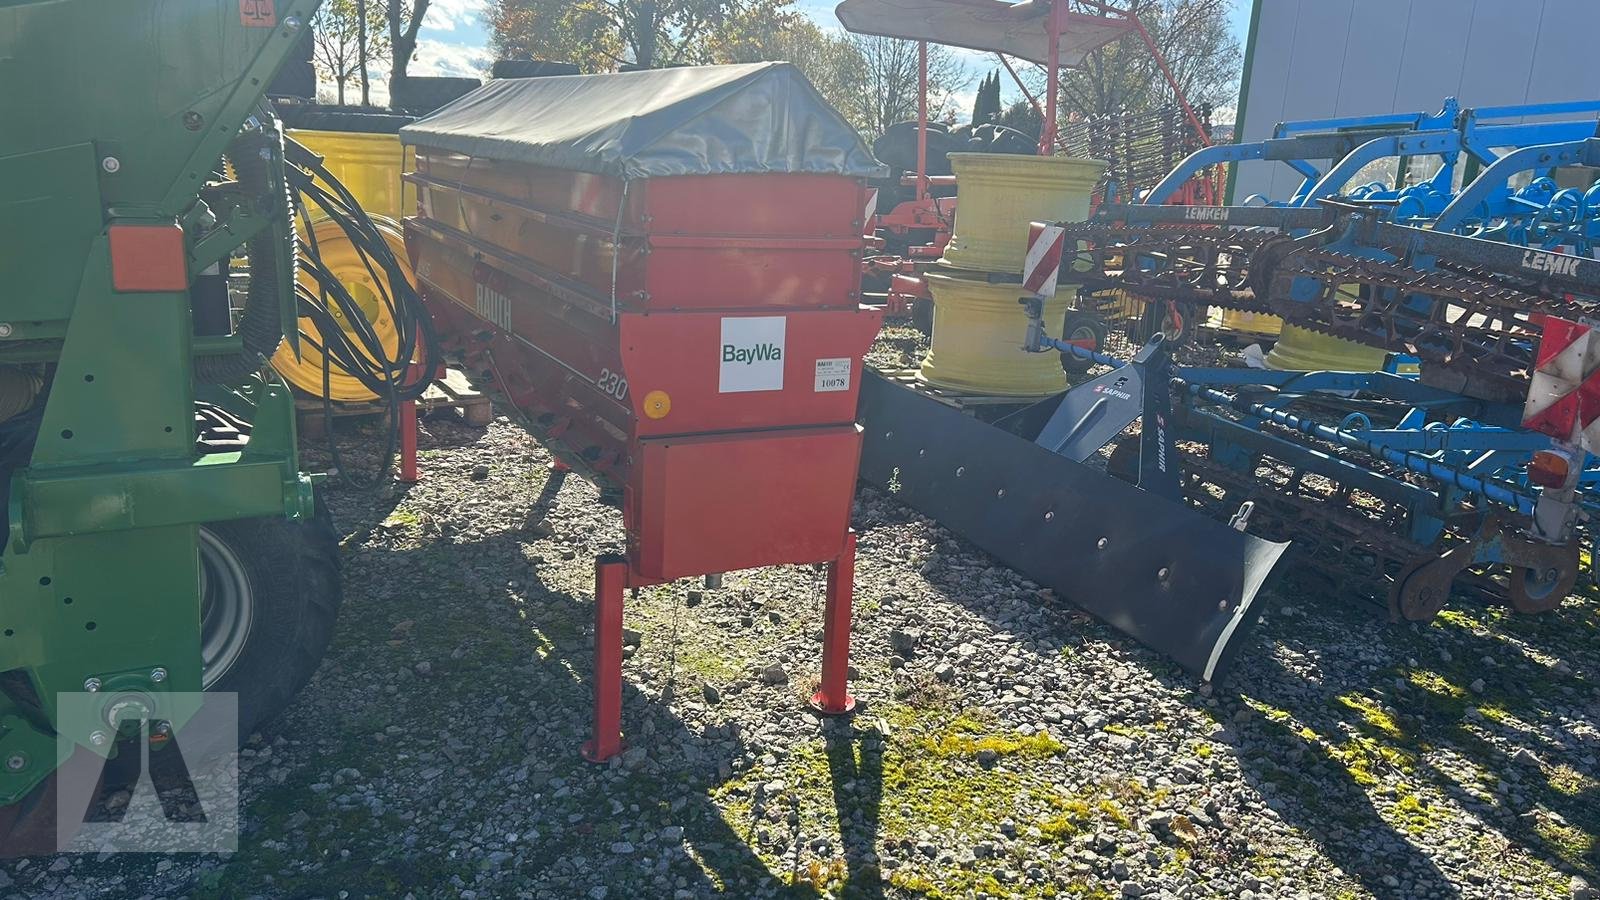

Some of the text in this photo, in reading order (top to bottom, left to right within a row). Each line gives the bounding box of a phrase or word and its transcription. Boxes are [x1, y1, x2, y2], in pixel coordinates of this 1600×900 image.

[1185, 207, 1230, 221] LEMKEN
[476, 282, 512, 334] RAUCH
[722, 343, 782, 366] BayWa
[598, 367, 628, 400] 230
[821, 377, 846, 389] 10078
[1102, 387, 1131, 400] SAPHIR
[1158, 426, 1167, 473] SAPHIR
